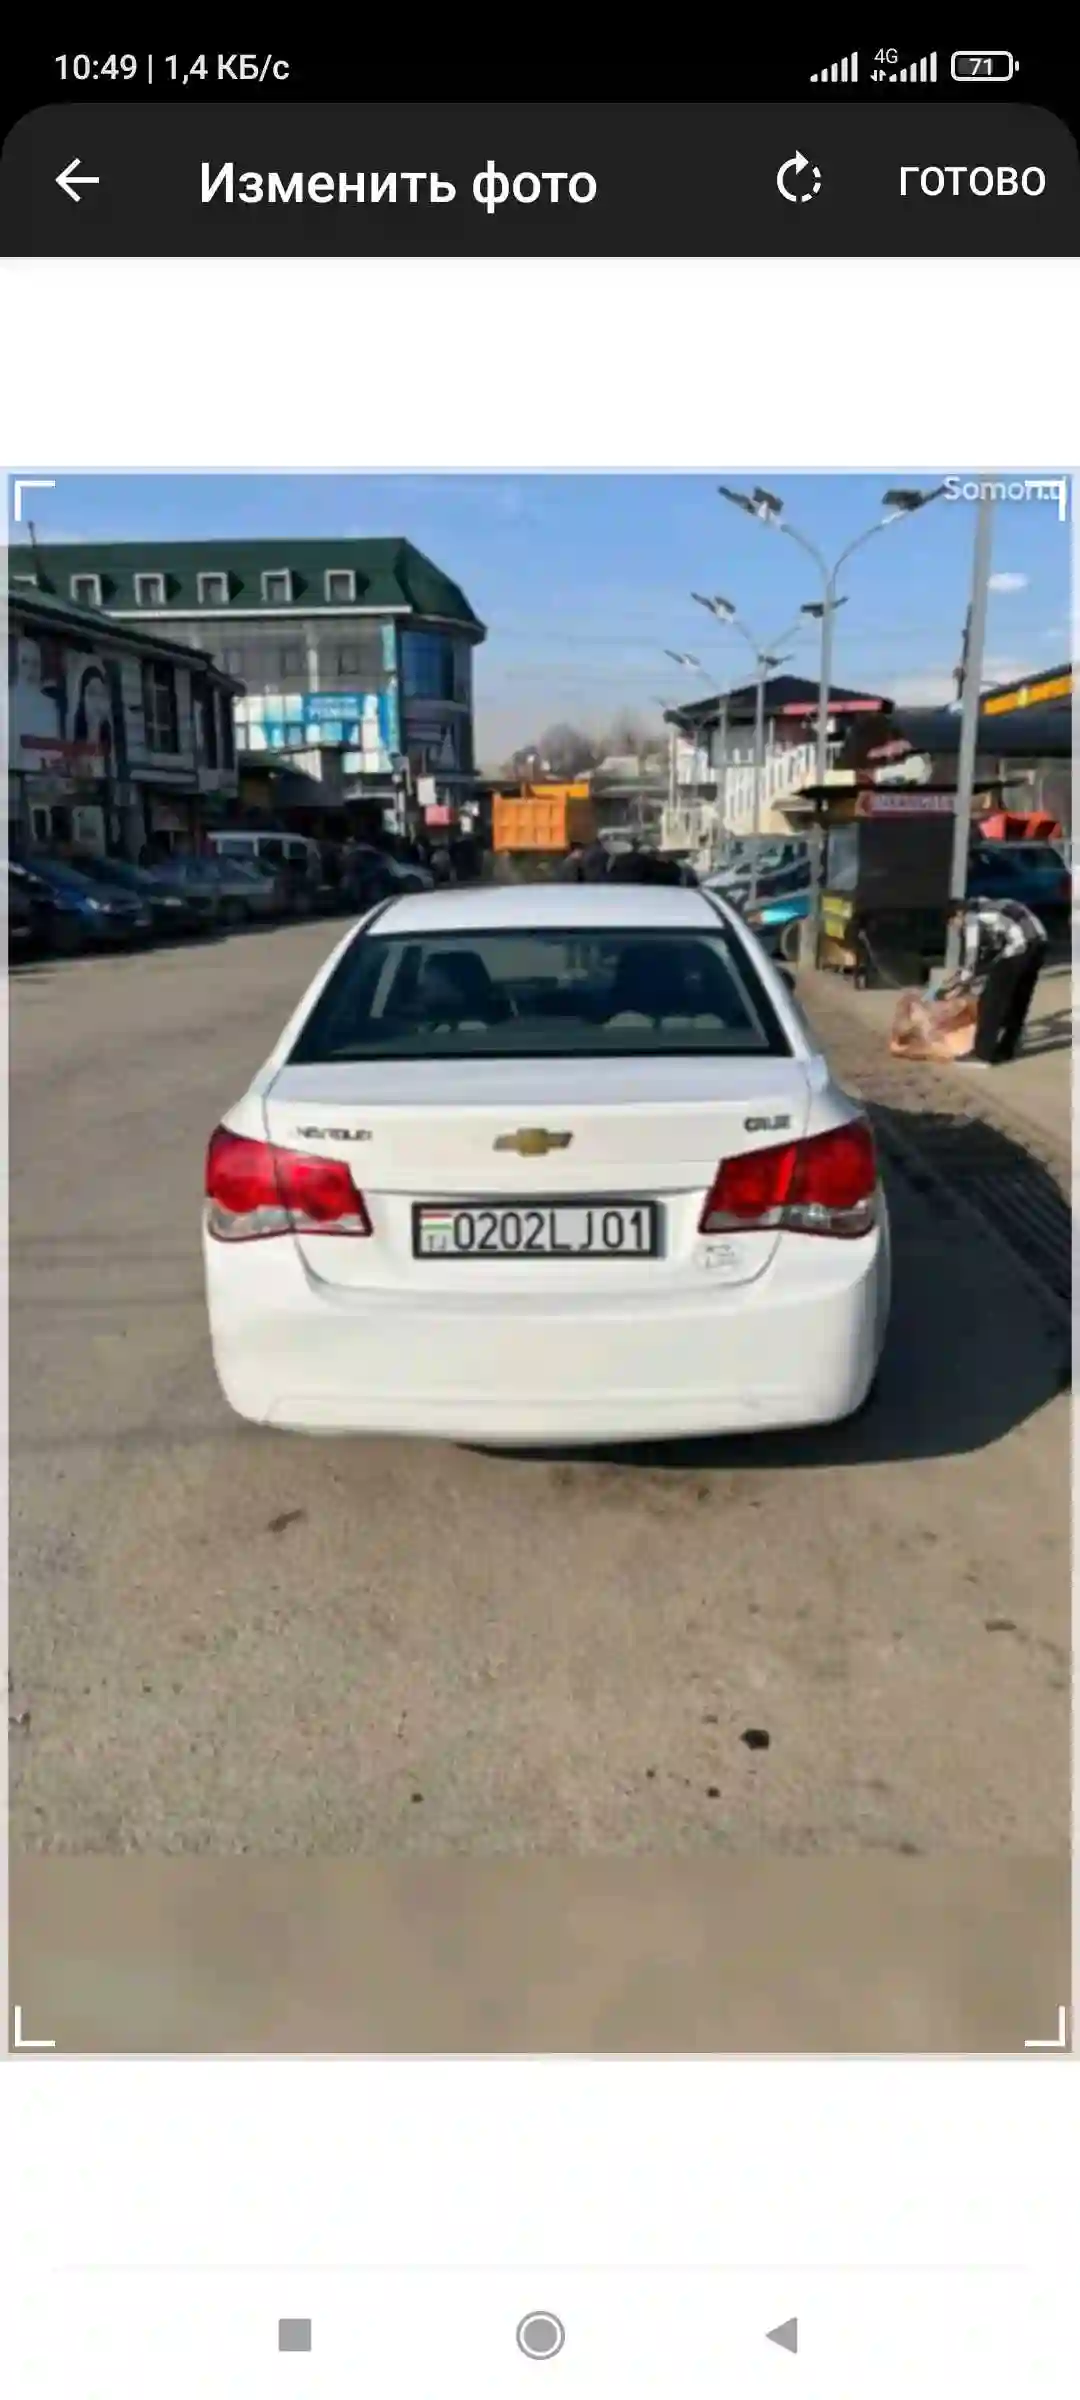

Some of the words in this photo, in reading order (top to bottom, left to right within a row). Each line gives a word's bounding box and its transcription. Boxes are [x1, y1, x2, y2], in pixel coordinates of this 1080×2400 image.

[55, 54, 137, 80] 10:49
[165, 54, 209, 85] 1,4
[217, 54, 290, 82] КБ/с
[874, 47, 898, 64] 4G
[968, 57, 992, 76] 71
[201, 162, 457, 205] Изменить
[472, 159, 597, 214] фото
[900, 166, 1046, 197] ГОТОВО
